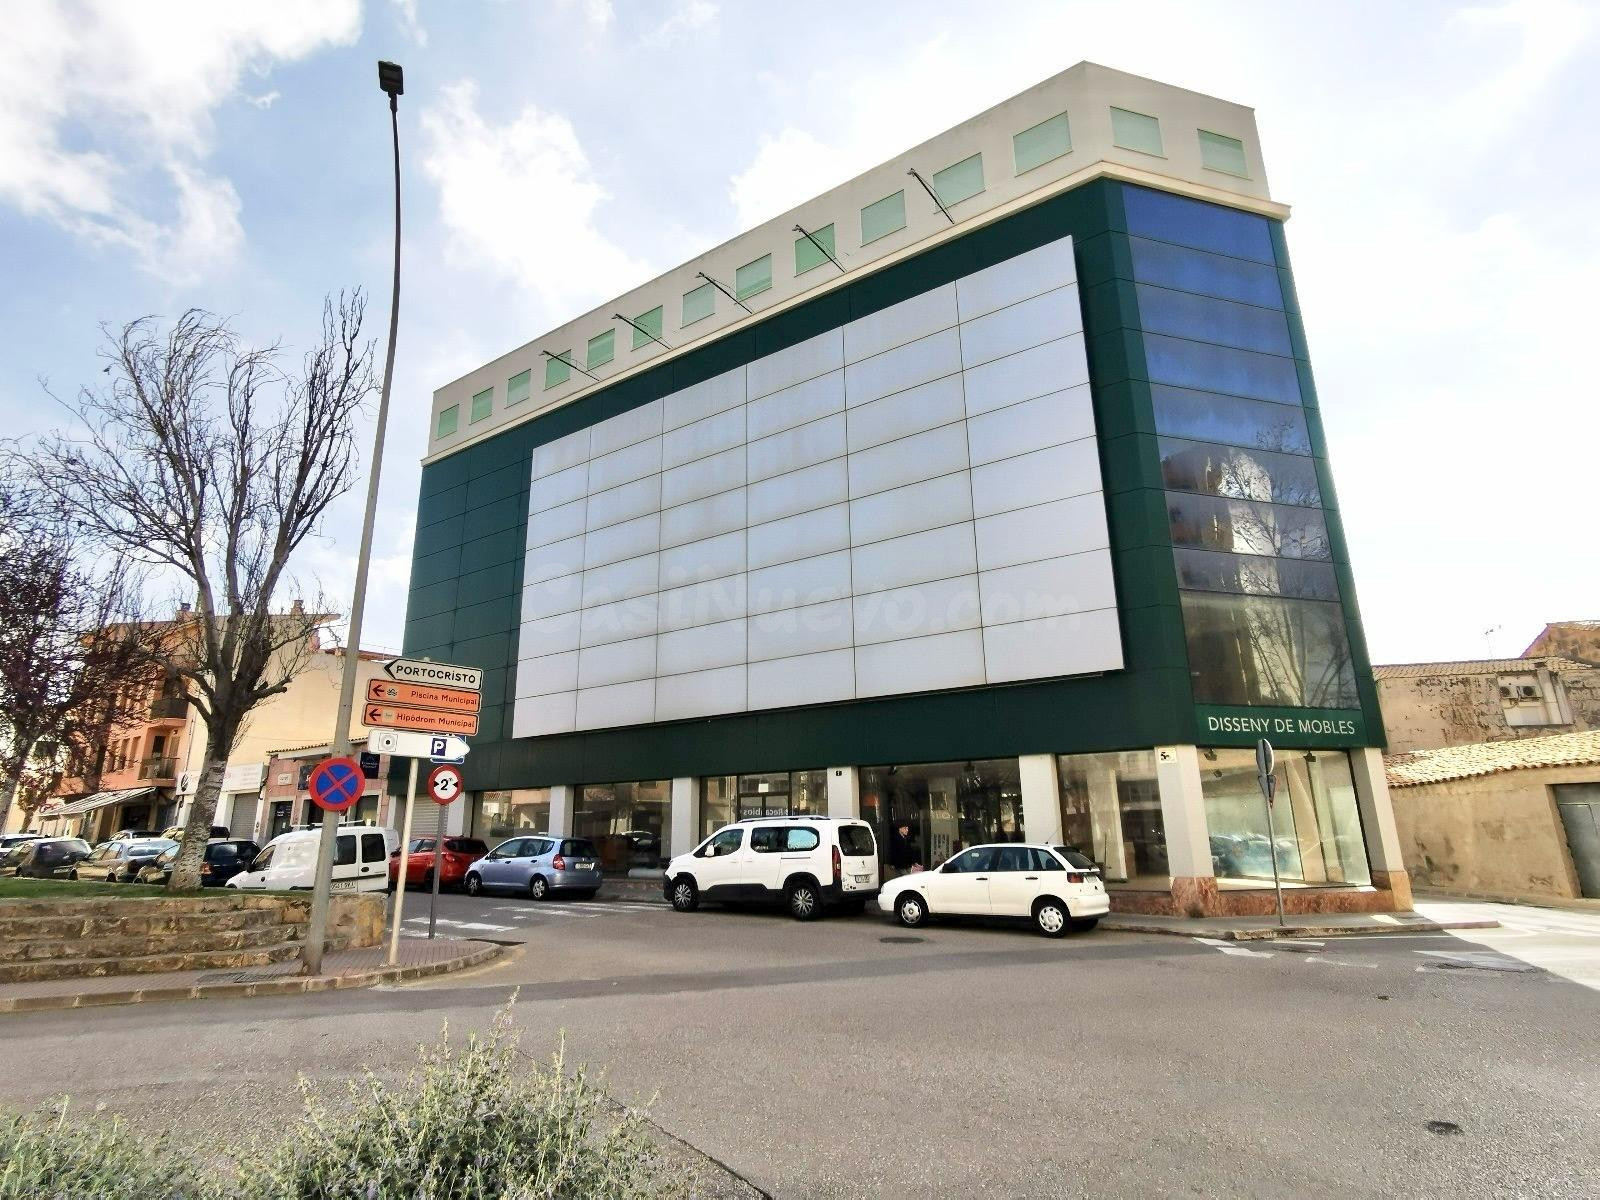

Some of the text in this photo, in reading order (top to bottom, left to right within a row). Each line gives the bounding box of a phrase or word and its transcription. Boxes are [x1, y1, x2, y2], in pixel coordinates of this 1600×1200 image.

[411, 690, 477, 705] Piscina Municipal
[438, 717, 475, 728] Municipal
[1208, 716, 1355, 735] DISSENY DE MOBLES
[433, 741, 445, 753] P
